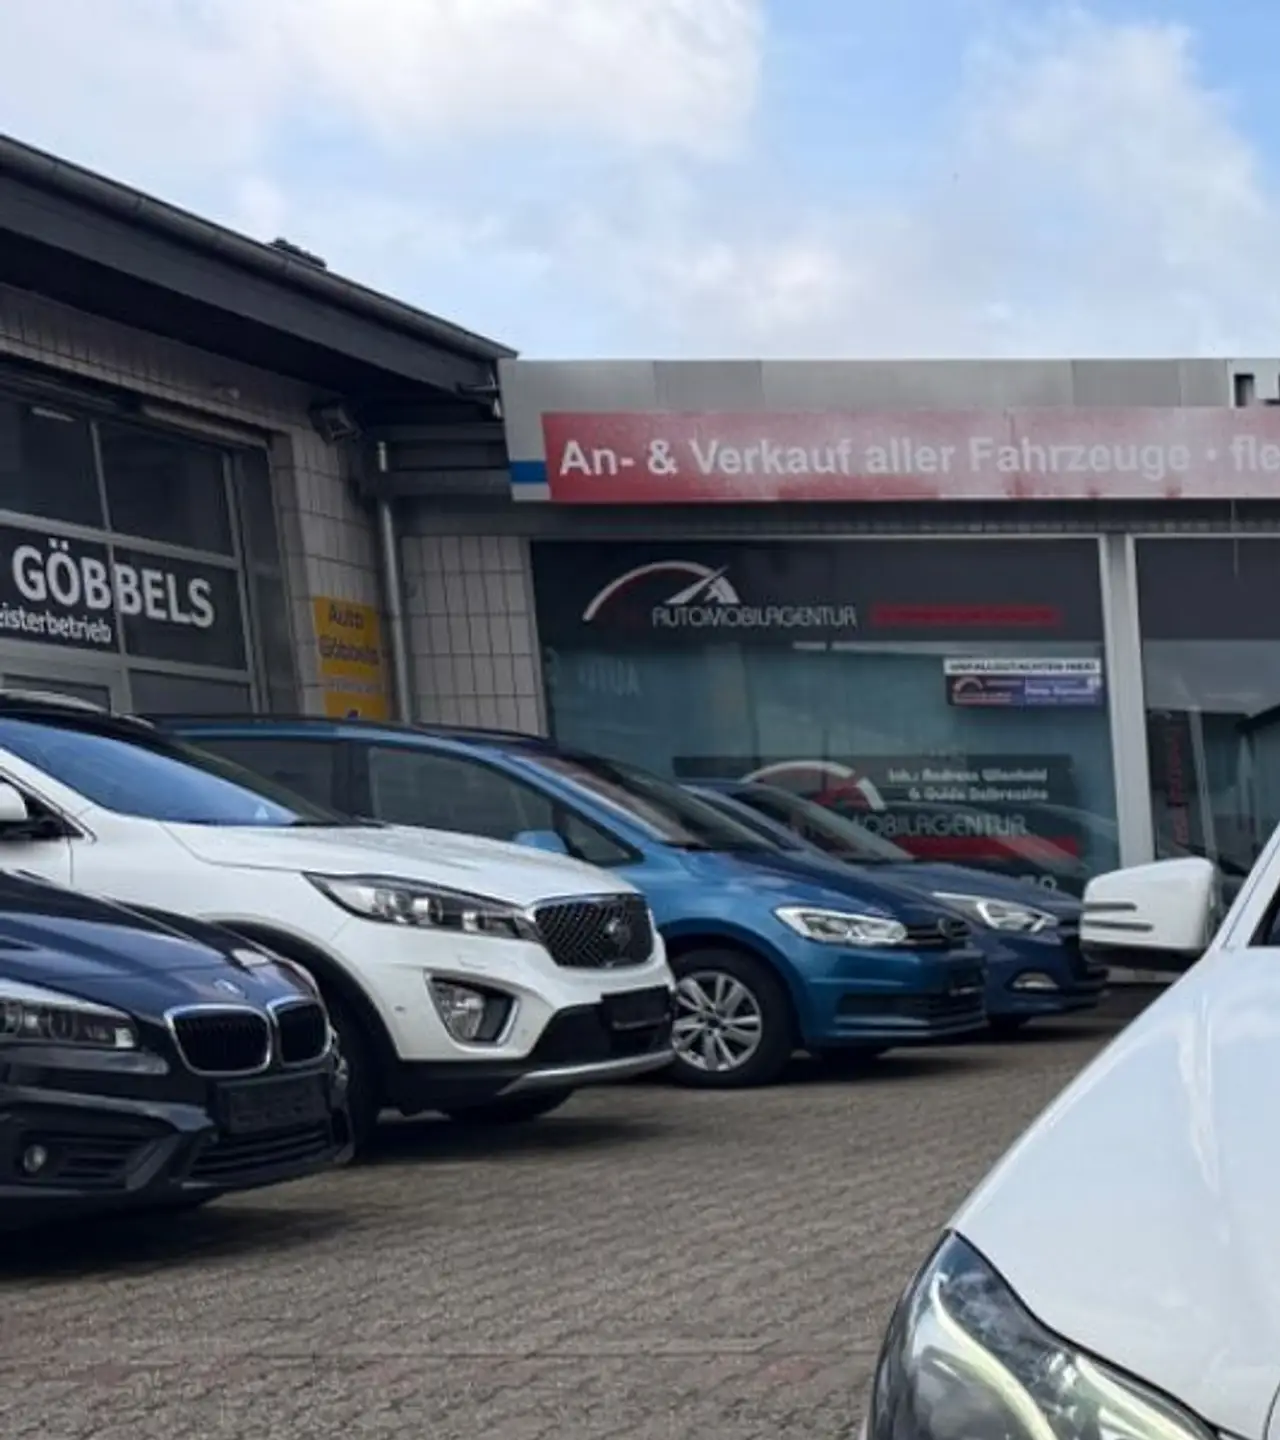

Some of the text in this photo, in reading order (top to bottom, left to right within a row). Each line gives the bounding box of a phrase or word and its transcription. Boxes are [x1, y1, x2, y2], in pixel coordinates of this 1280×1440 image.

[560, 440, 635, 476] An-
[646, 438, 678, 476] &
[689, 438, 852, 475] Verkauf
[864, 437, 955, 474] aller
[968, 436, 1191, 482] Fahrzeuge
[12, 537, 214, 629] GÖBBELS
[652, 606, 858, 628] AUTOMOBILAGENTUR
